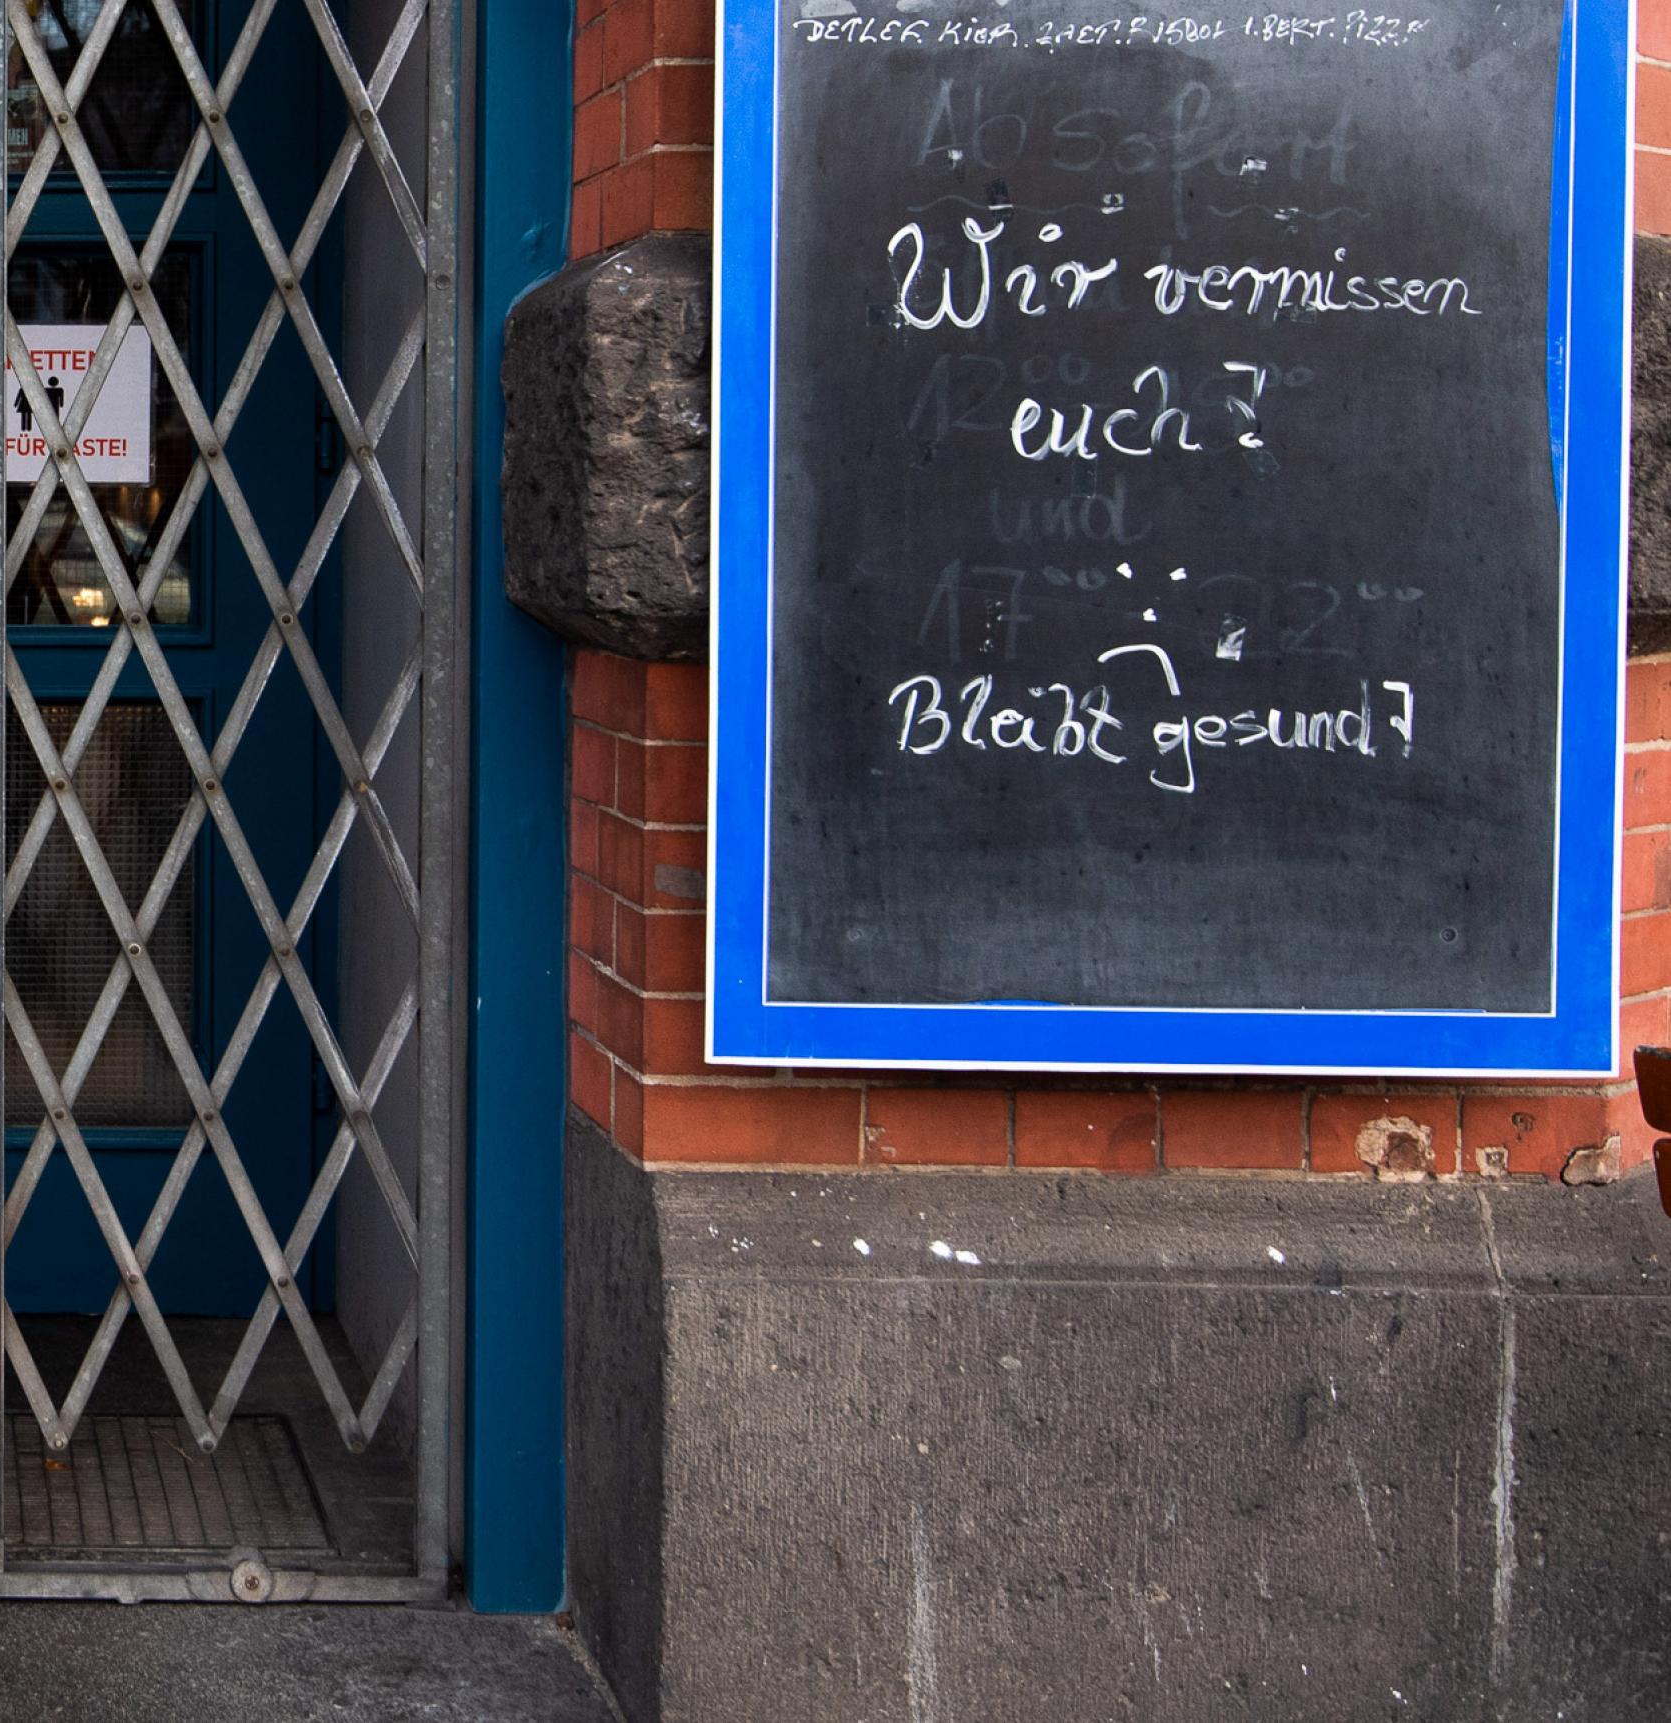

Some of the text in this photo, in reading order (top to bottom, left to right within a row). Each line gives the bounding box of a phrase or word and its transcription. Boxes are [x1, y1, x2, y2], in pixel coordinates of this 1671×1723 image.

[886, 217, 1482, 330] Wir vermissen
[888, 674, 1127, 767] Bleibt
